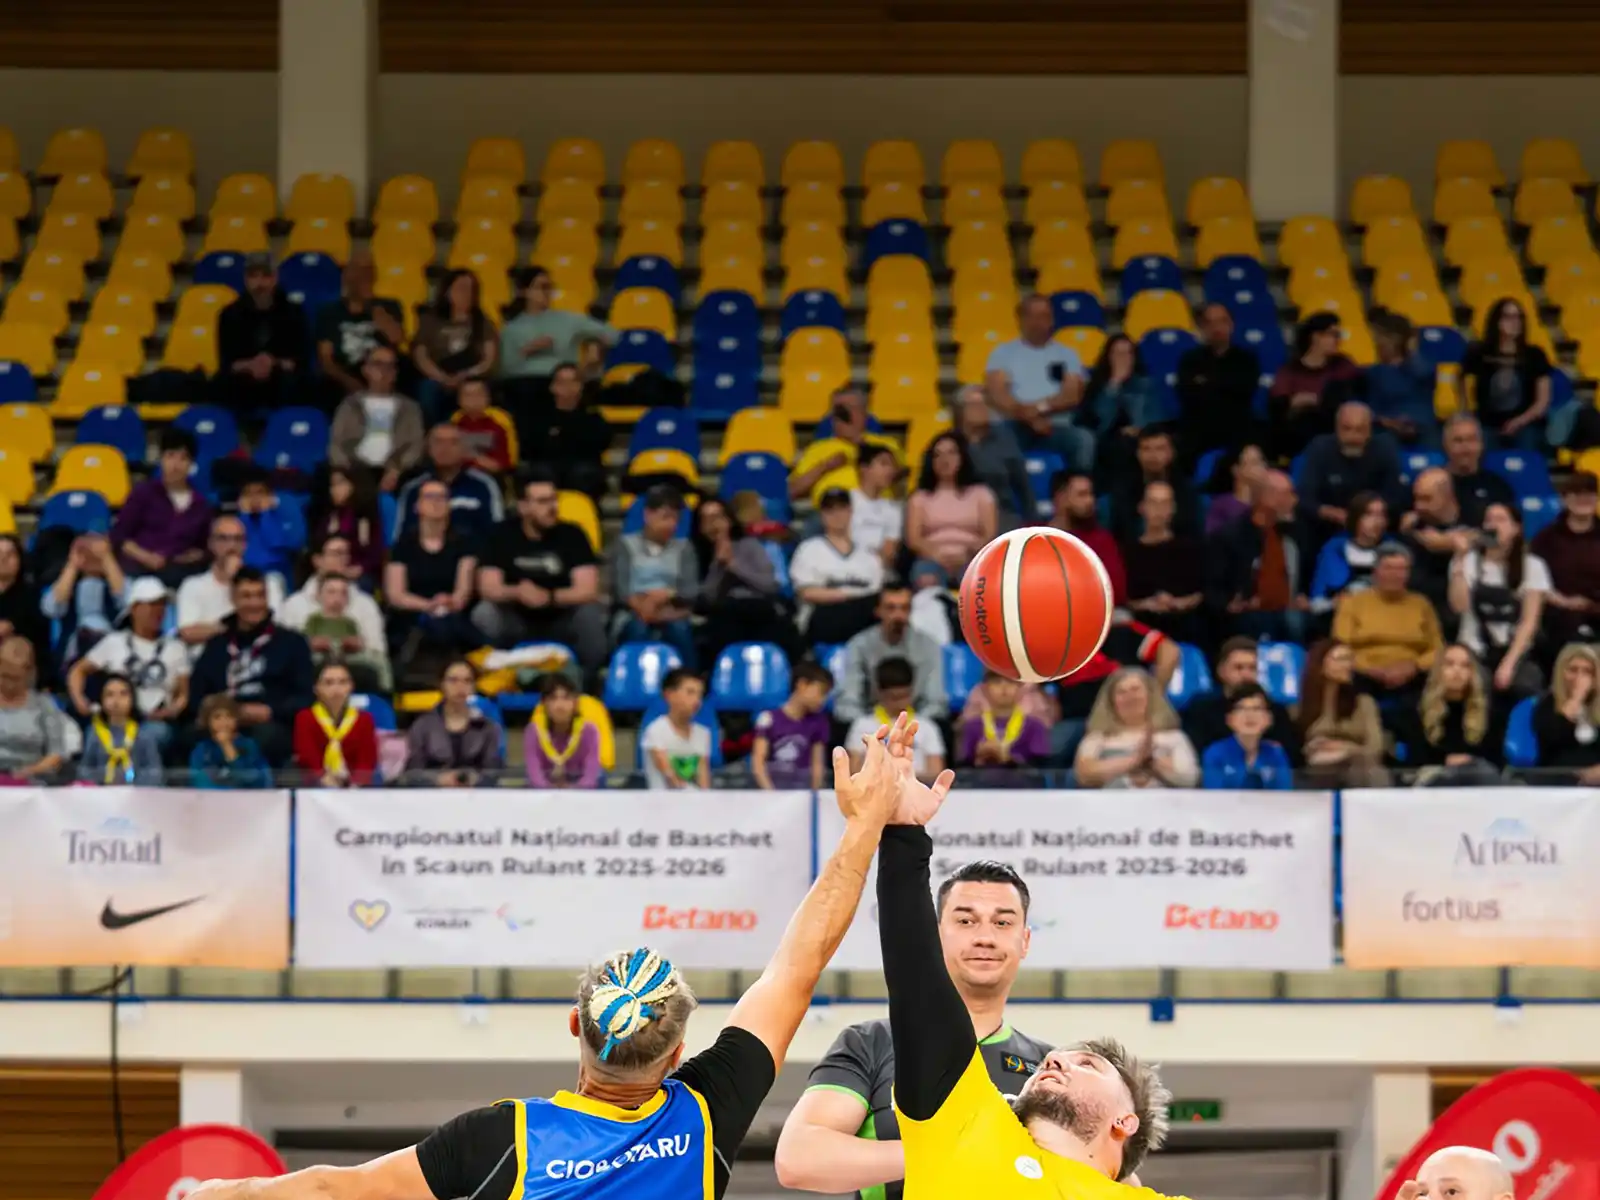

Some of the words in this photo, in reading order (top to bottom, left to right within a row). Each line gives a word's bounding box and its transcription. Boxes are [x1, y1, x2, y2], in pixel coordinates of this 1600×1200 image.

[975, 577, 991, 645] molten
[335, 826, 501, 850] Campionatul
[627, 829, 659, 847] de
[669, 829, 773, 847] Baschet
[1149, 829, 1180, 847] de
[1190, 829, 1294, 848] Baschet
[414, 857, 494, 876] Scaun
[502, 857, 586, 875] Rulant
[595, 857, 726, 876] 2025-2026
[1023, 858, 1107, 875] Rulant
[1116, 858, 1247, 875] 2025-2026
[642, 904, 758, 930] Betano
[1163, 904, 1279, 931] Betano
[1403, 892, 1501, 922] fortius
